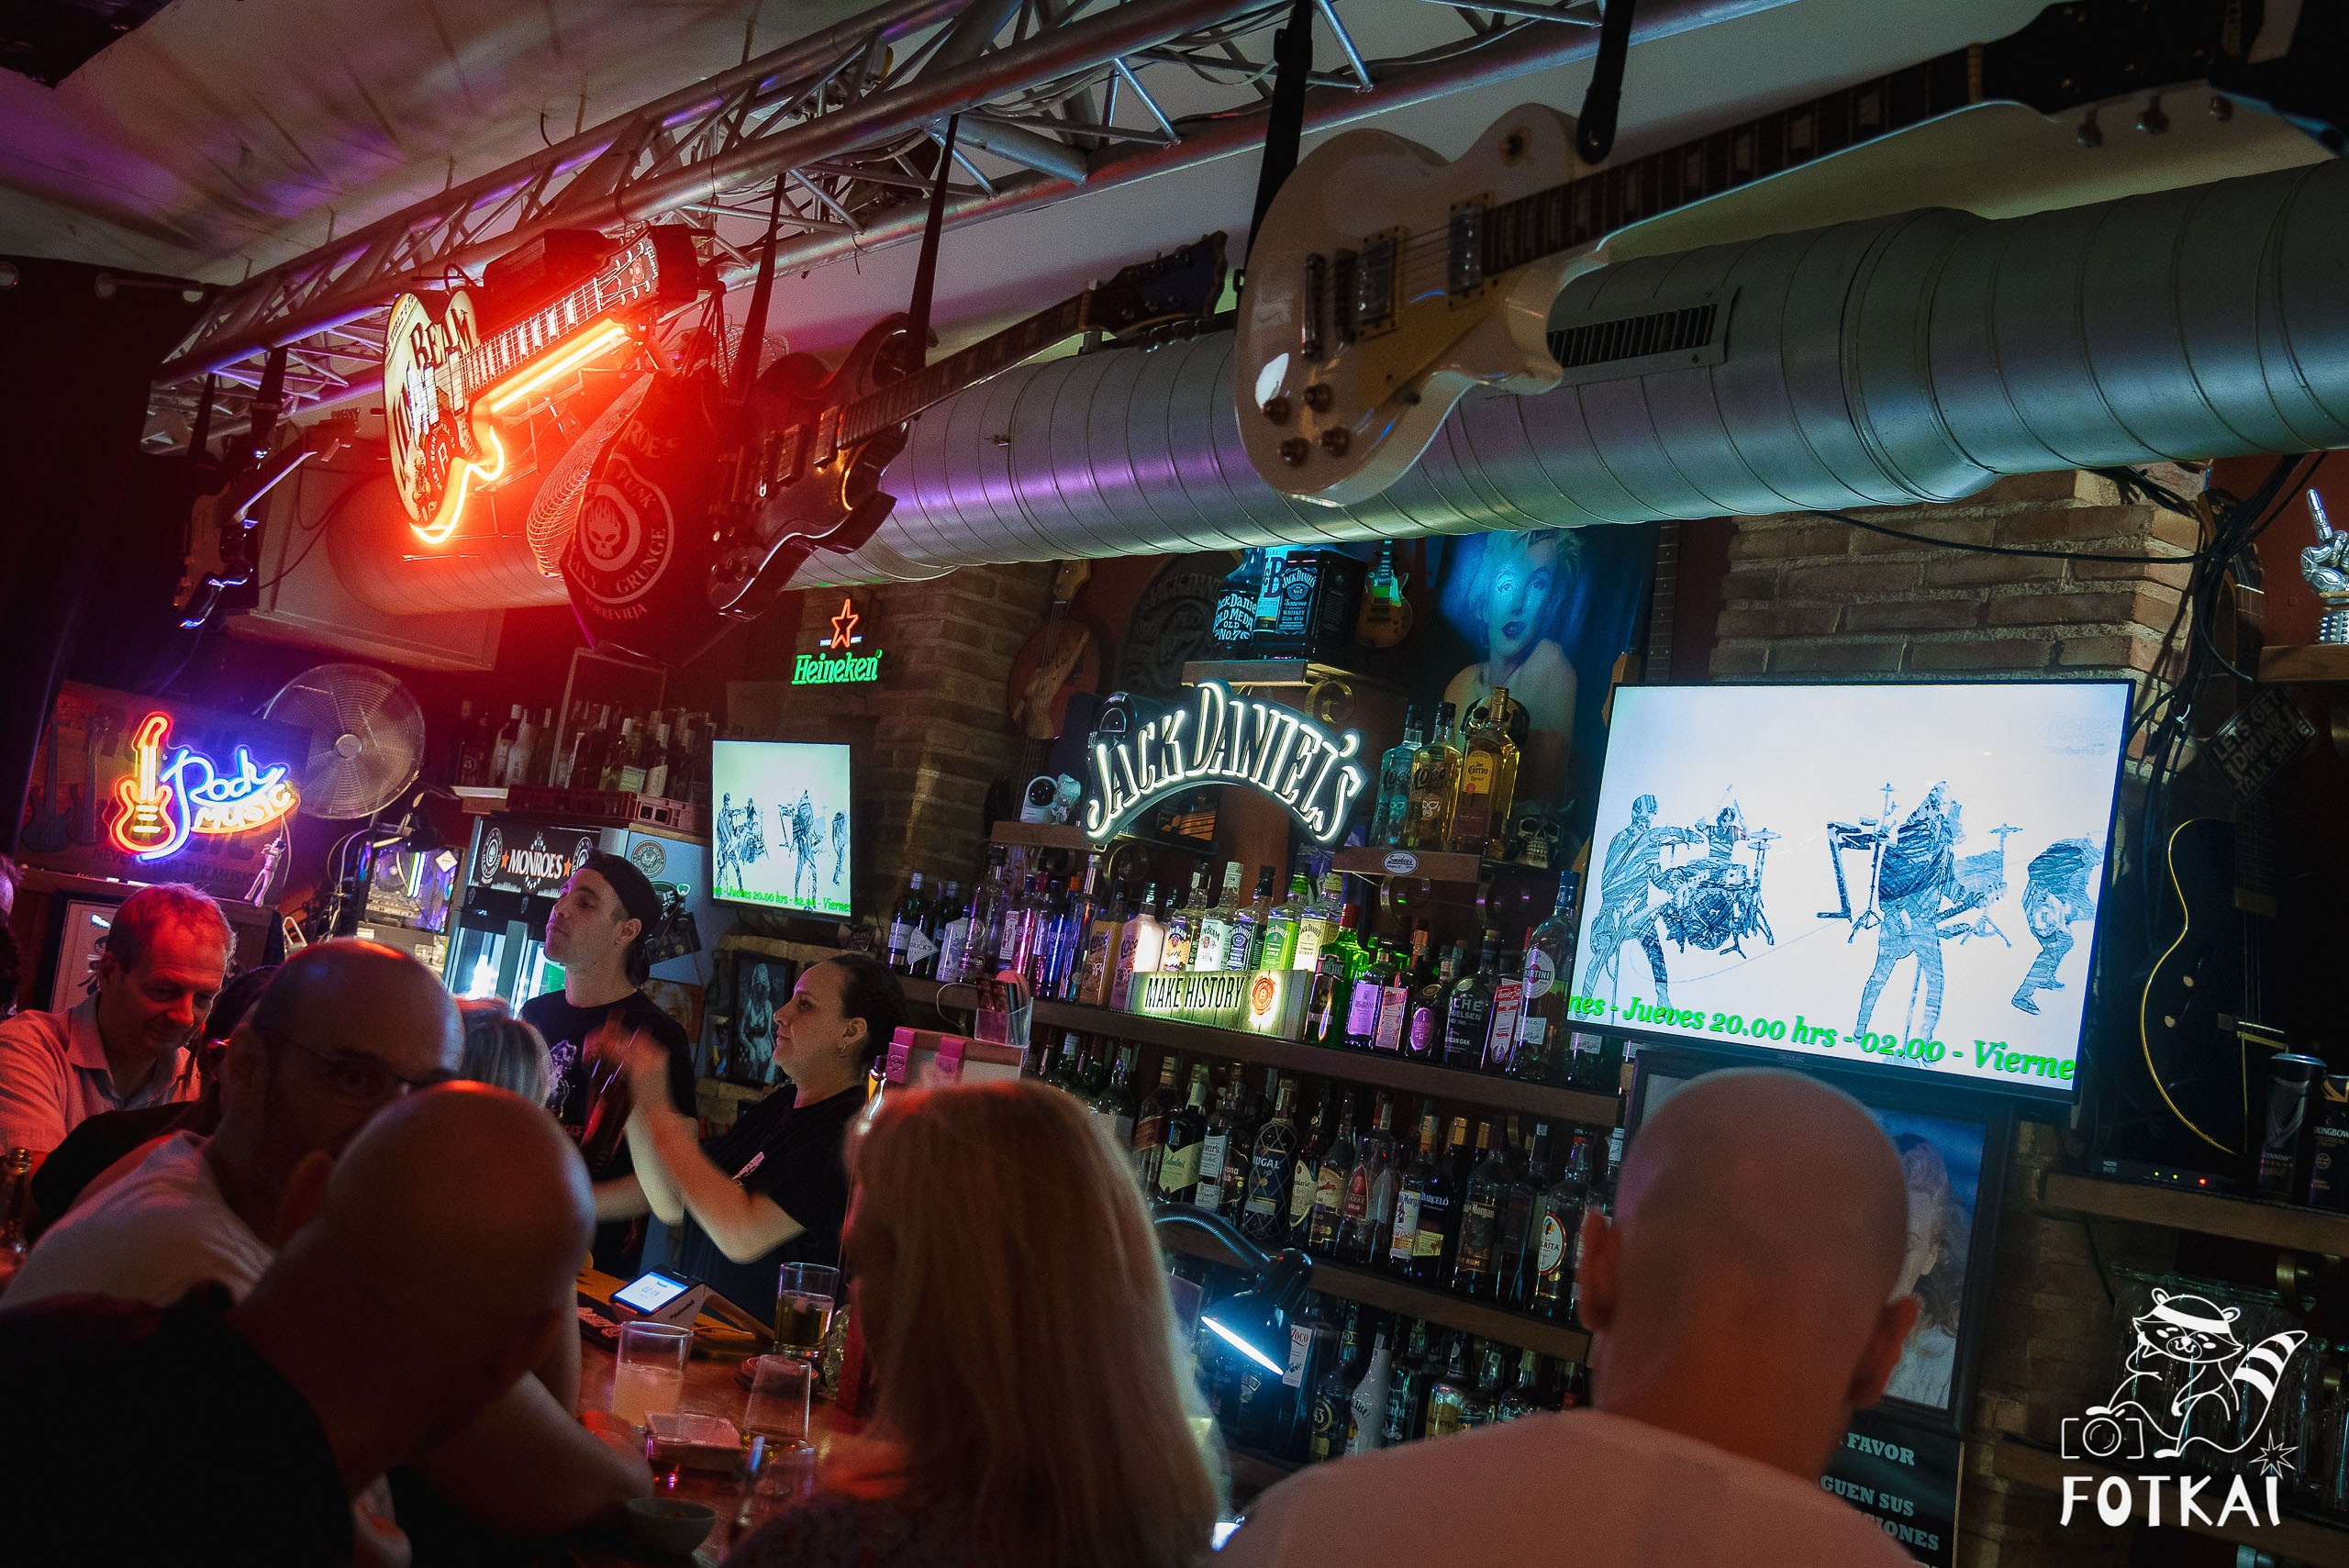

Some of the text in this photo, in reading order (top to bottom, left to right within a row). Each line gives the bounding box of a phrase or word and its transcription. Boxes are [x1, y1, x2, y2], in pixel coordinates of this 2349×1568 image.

[410, 307, 471, 367] BEAM
[616, 528, 666, 595] GRUNGE
[1282, 569, 1318, 589] JACK DANIEL'S
[1222, 620, 1240, 628] OLD
[1229, 608, 1253, 633] MEDA
[791, 650, 880, 685] Heineken
[1086, 682, 1362, 841] JACK DANIEL'S
[1468, 765, 1488, 776] Cuervo
[193, 783, 292, 830] MUSIC
[1524, 968, 1551, 981] MARTINI
[1144, 975, 1245, 1008] MAKE HISTORY
[1623, 996, 1705, 1030] Jueves
[1710, 1012, 1787, 1041] 20.00
[1791, 1015, 1837, 1049] hrs
[1861, 1031, 1945, 1062] 02.00
[1974, 1040, 2076, 1080] Vierne
[1252, 1156, 1280, 1170] RUGAL
[1471, 1204, 1496, 1218] Morgan
[1313, 1406, 1325, 1423] 43
[1847, 1431, 1915, 1466] FAVOR
[1820, 1474, 1915, 1517] GUEN SUS
